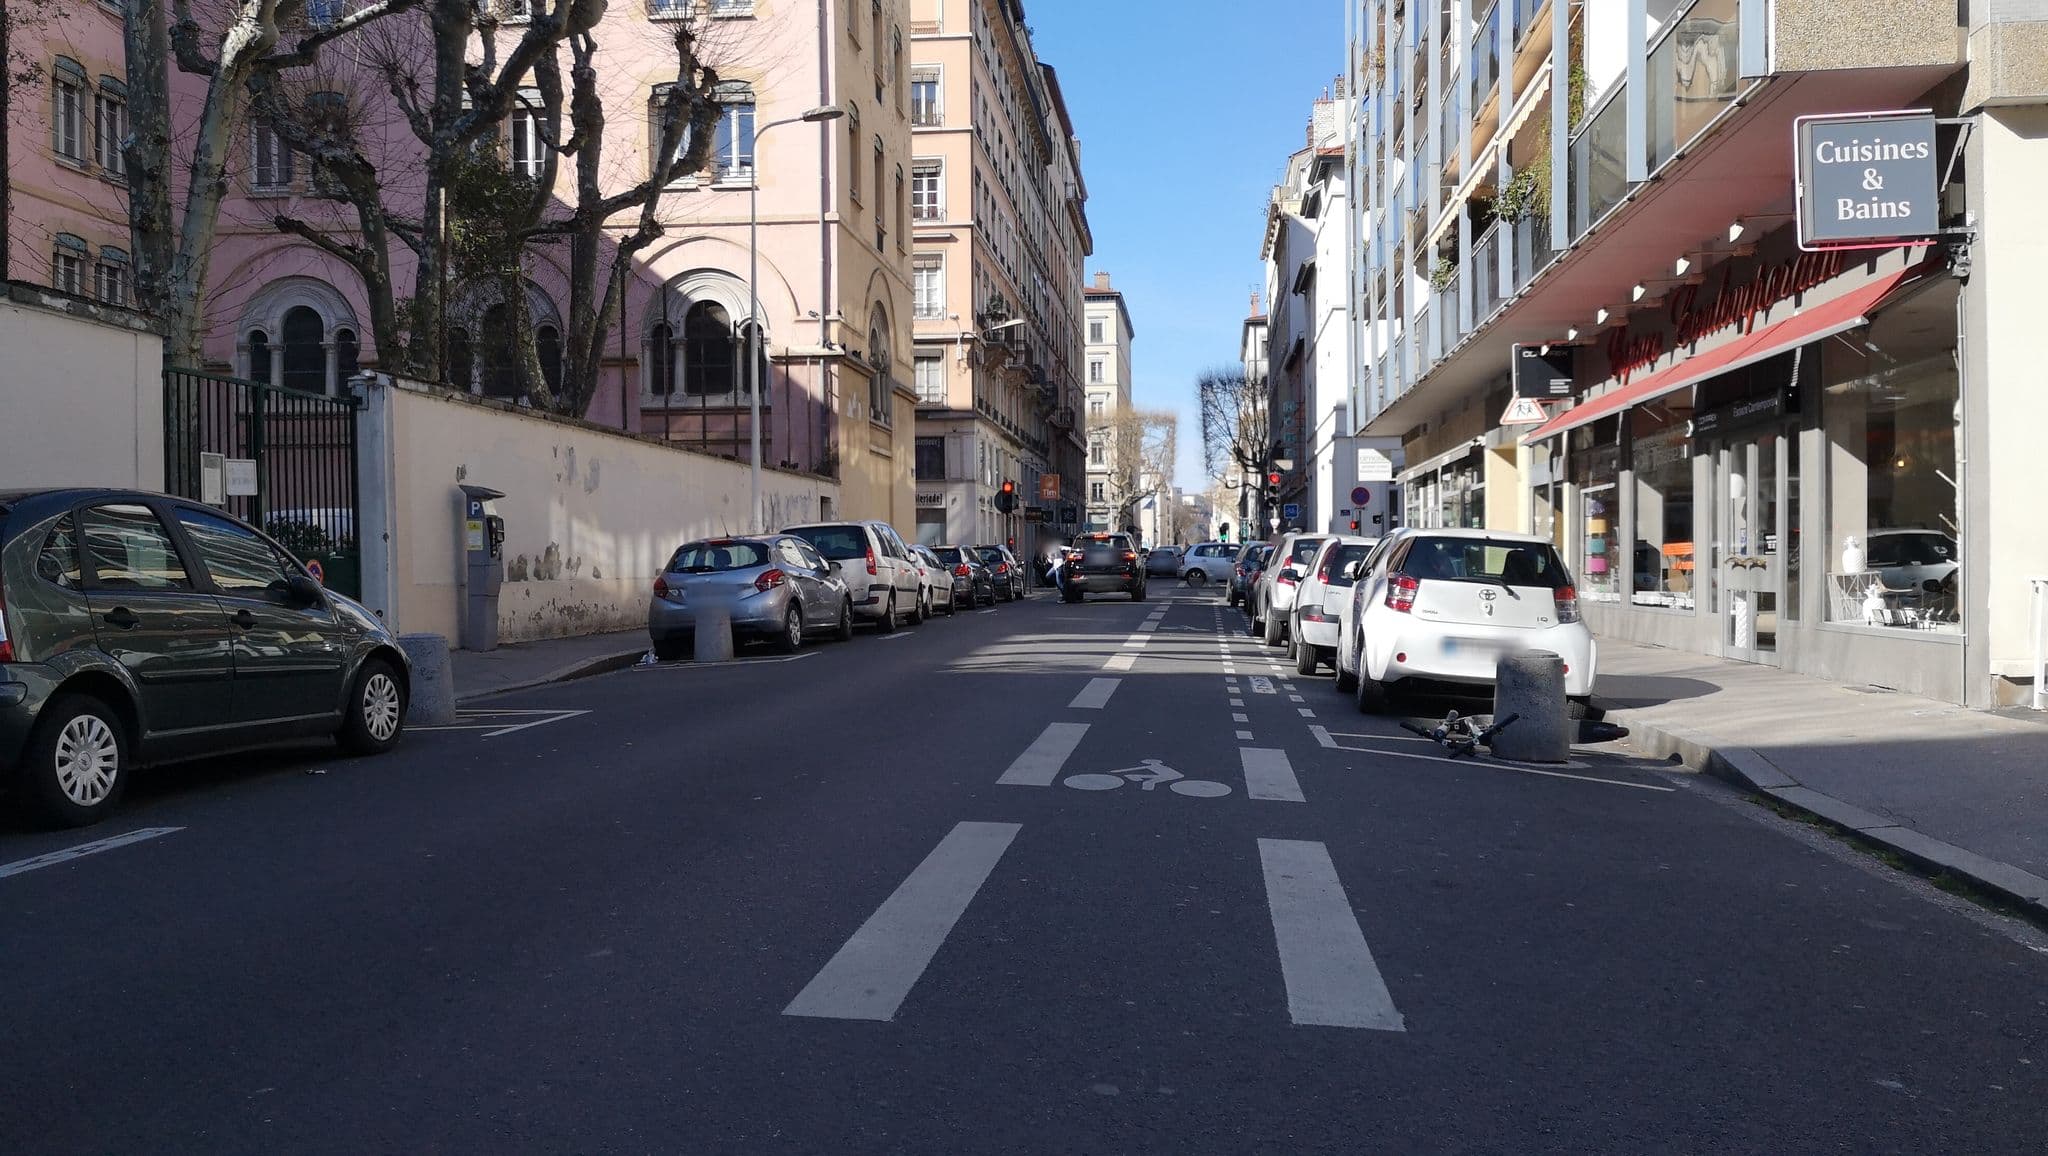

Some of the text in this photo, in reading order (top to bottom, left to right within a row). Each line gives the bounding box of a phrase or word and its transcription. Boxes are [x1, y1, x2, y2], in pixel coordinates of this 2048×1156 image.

[1815, 137, 1929, 164] Cuisines
[1862, 167, 1884, 190] &
[1837, 196, 1912, 220] Bains
[471, 501, 481, 515] P
